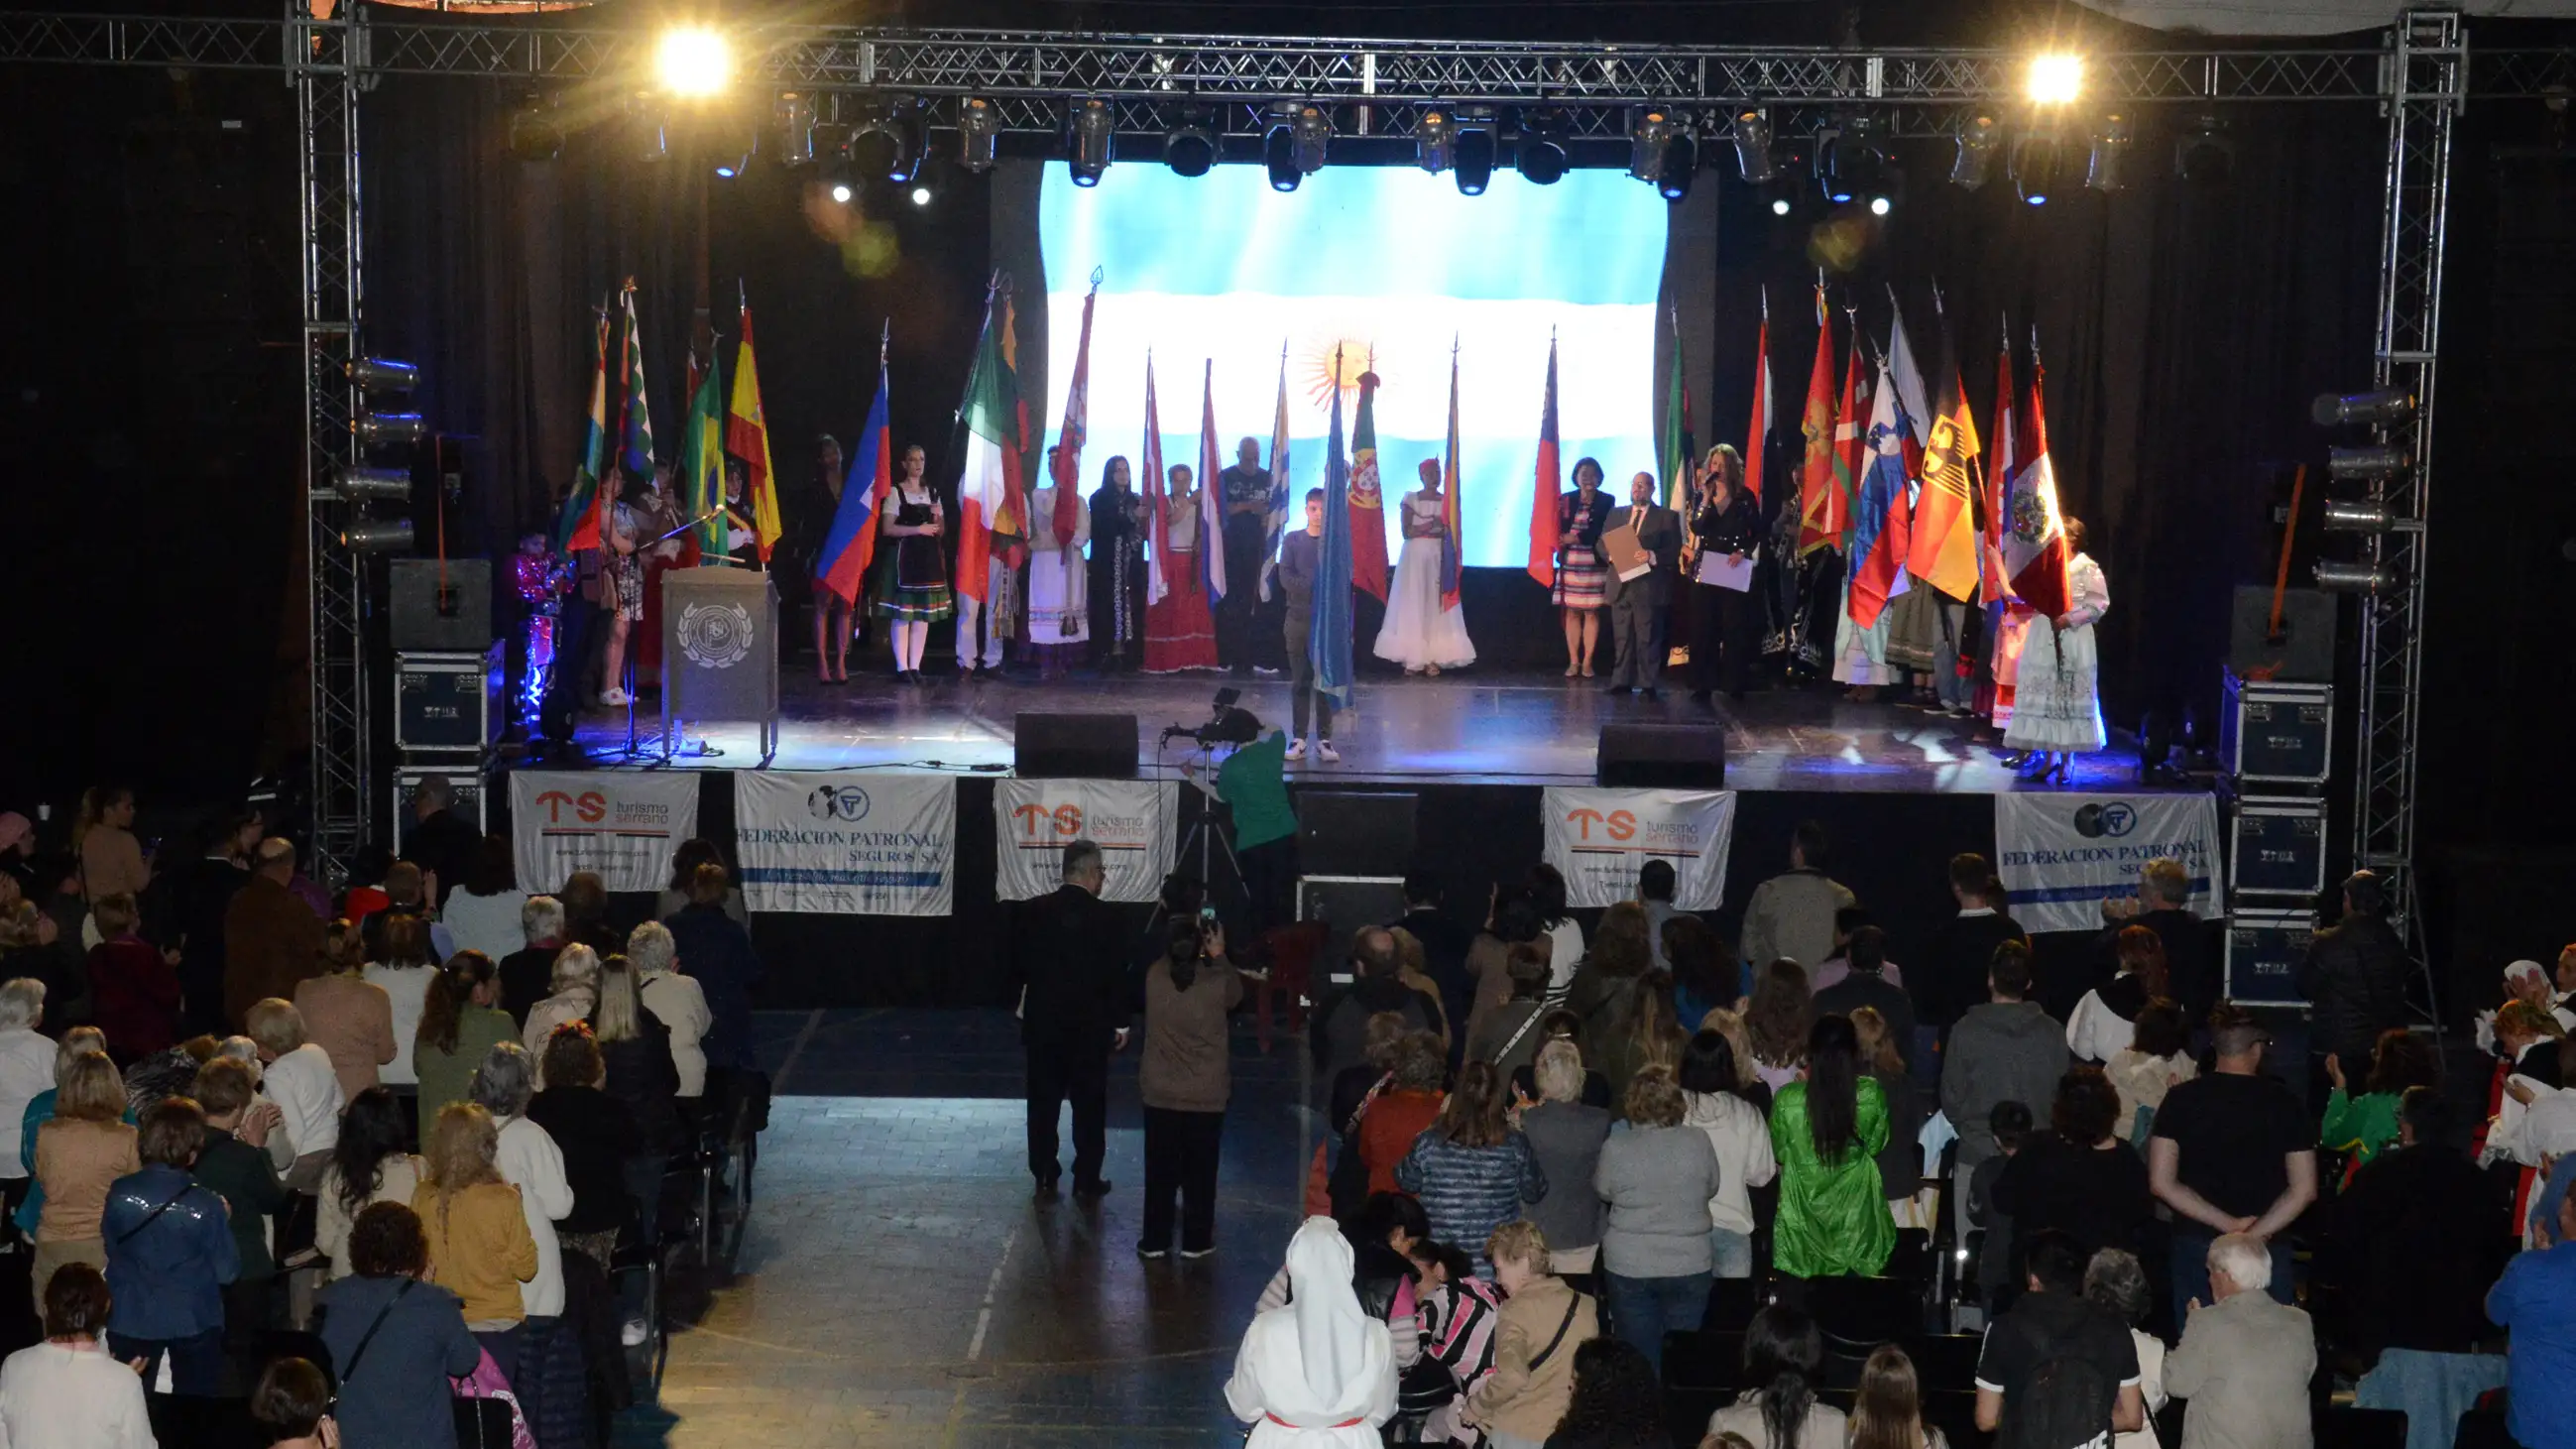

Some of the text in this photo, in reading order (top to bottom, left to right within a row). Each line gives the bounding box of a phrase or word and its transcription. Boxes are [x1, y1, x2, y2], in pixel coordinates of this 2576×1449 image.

[535, 790, 606, 822] TS
[616, 800, 669, 813] turismo
[615, 812, 669, 824] serrano
[1011, 802, 1083, 836] TS
[1566, 807, 1636, 841] TS
[1646, 820, 1698, 833] turismo
[850, 832, 945, 848] PATRONAL
[1646, 832, 1699, 844] serrano
[849, 849, 914, 864] SEGUROS
[2003, 840, 2209, 867] FEDERACION PATRONAL
